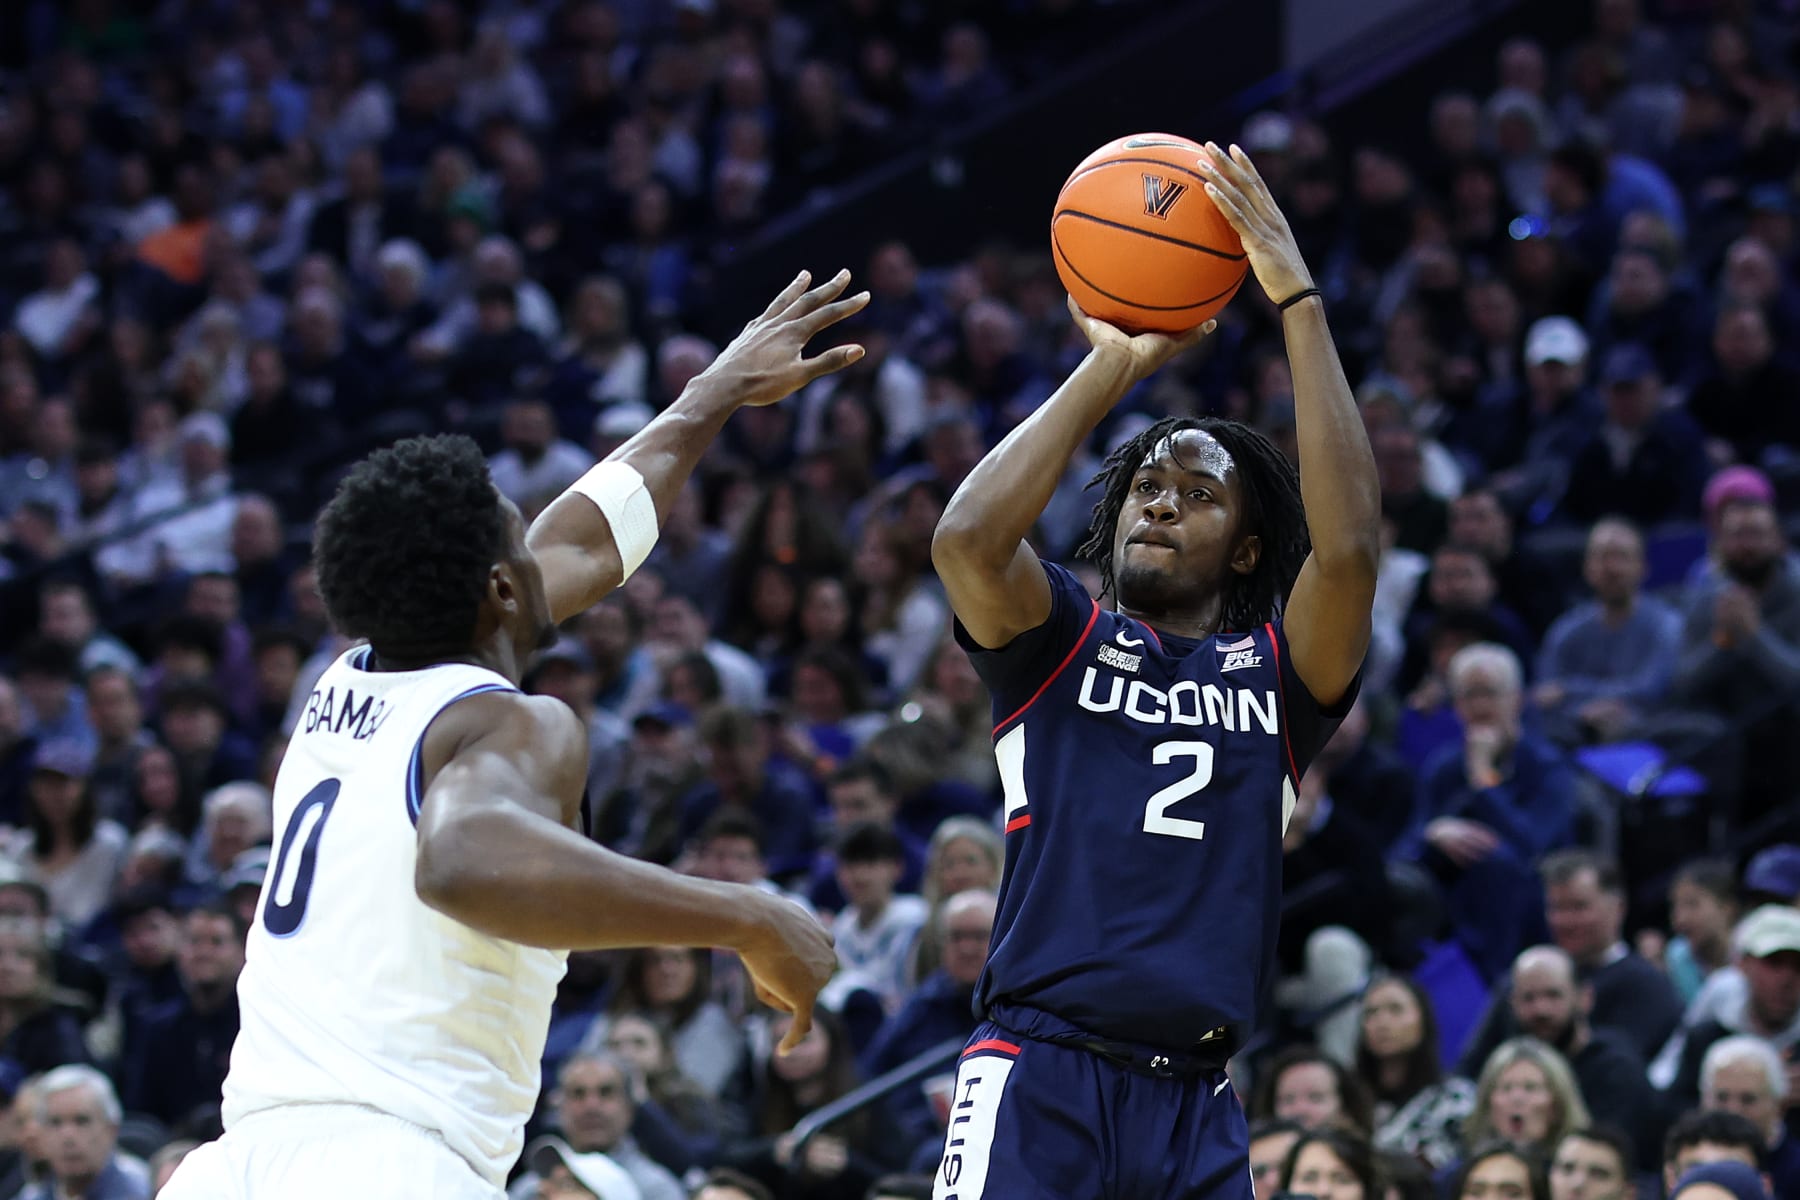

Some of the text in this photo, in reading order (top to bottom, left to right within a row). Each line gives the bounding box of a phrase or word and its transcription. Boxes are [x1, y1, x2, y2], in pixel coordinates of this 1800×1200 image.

[1097, 653, 1139, 672] CHANGE
[1107, 647, 1127, 662] BE
[1223, 656, 1263, 669] EAST
[1225, 649, 1254, 661] BIG
[1077, 666, 1279, 735] UCONN
[1143, 741, 1214, 840] 2
[263, 777, 341, 939] 0
[944, 1077, 982, 1200] HUS
